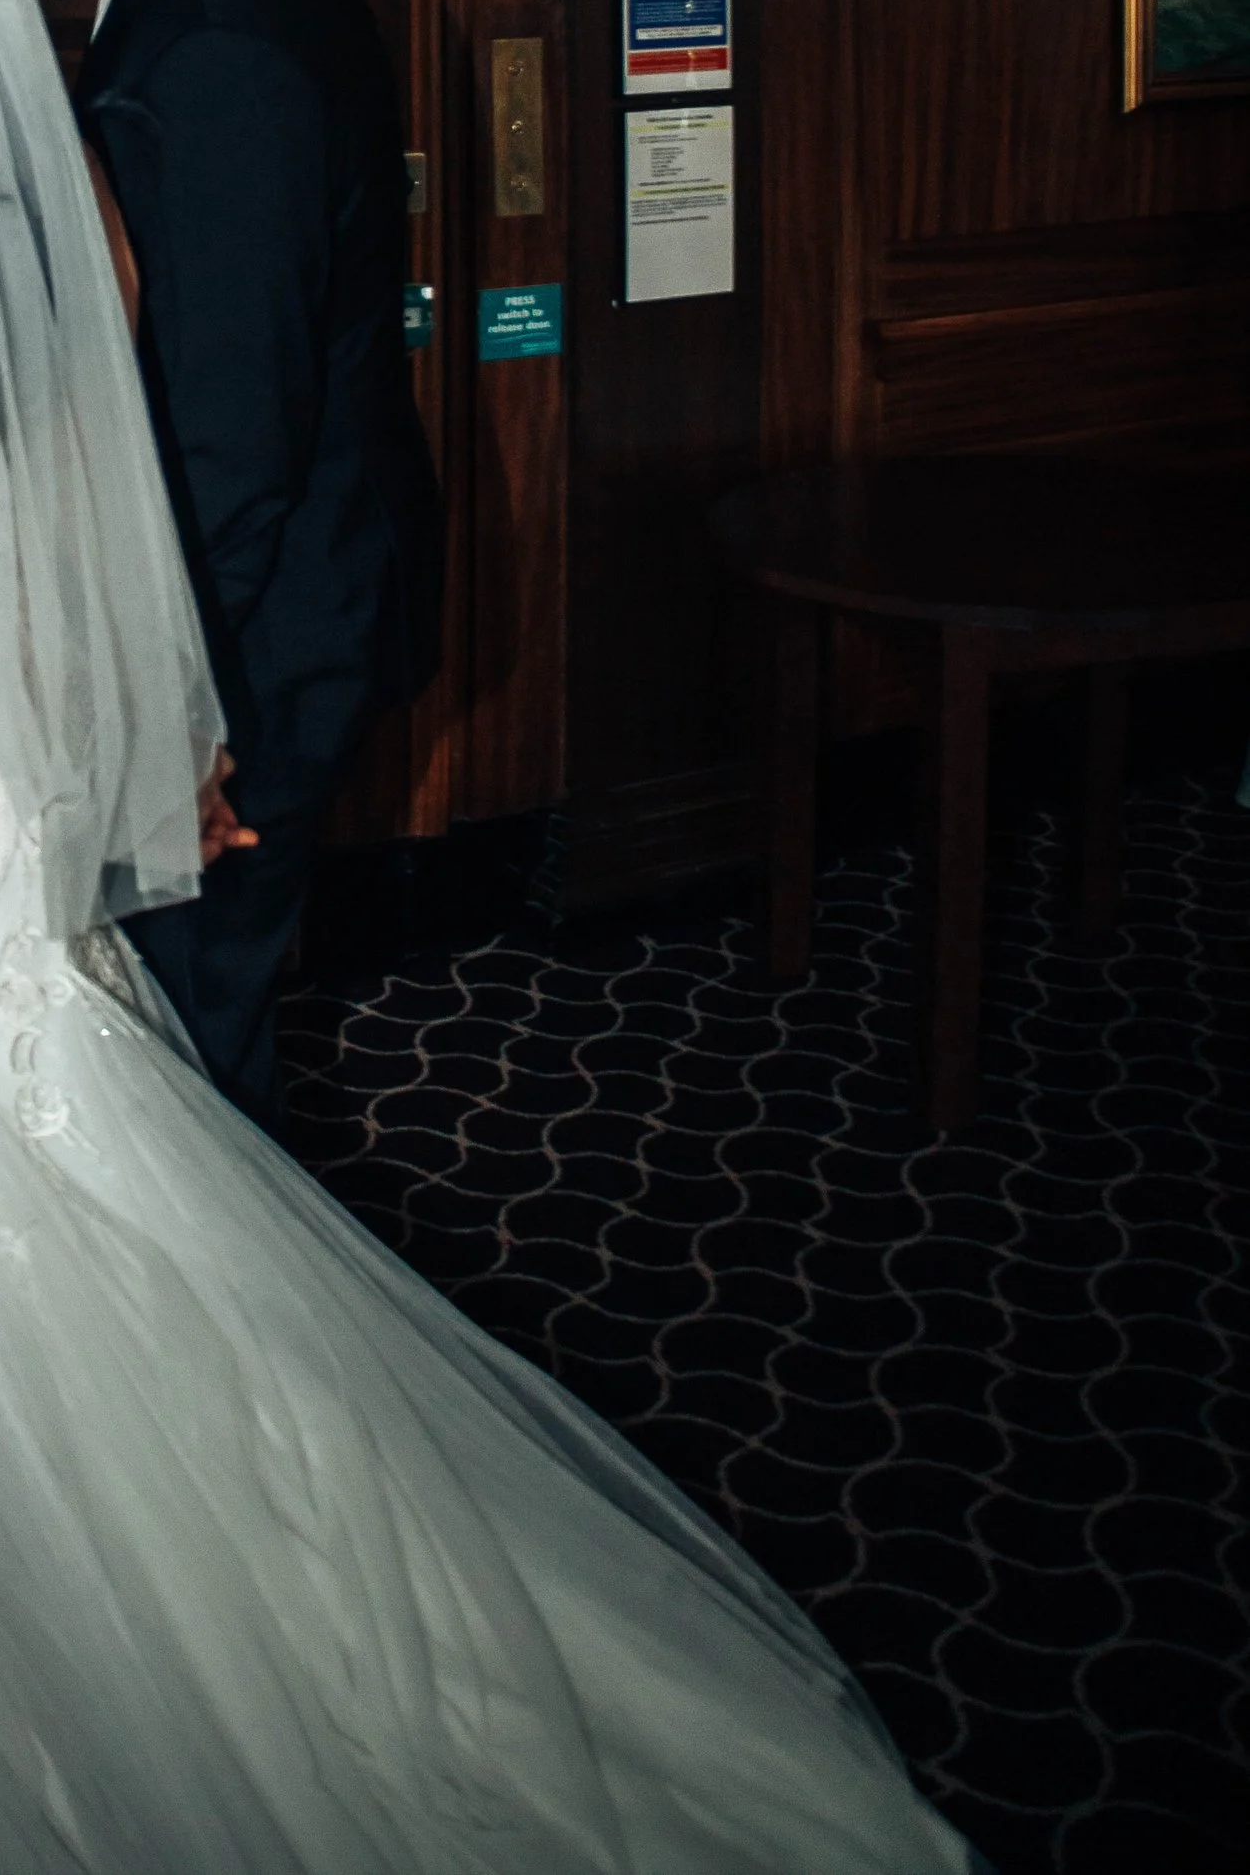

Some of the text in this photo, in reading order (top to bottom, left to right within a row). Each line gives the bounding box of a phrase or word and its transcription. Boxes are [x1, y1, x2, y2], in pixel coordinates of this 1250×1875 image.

[505, 294, 536, 306] PRESS
[497, 308, 544, 320] switch to
[487, 322, 524, 333] release
